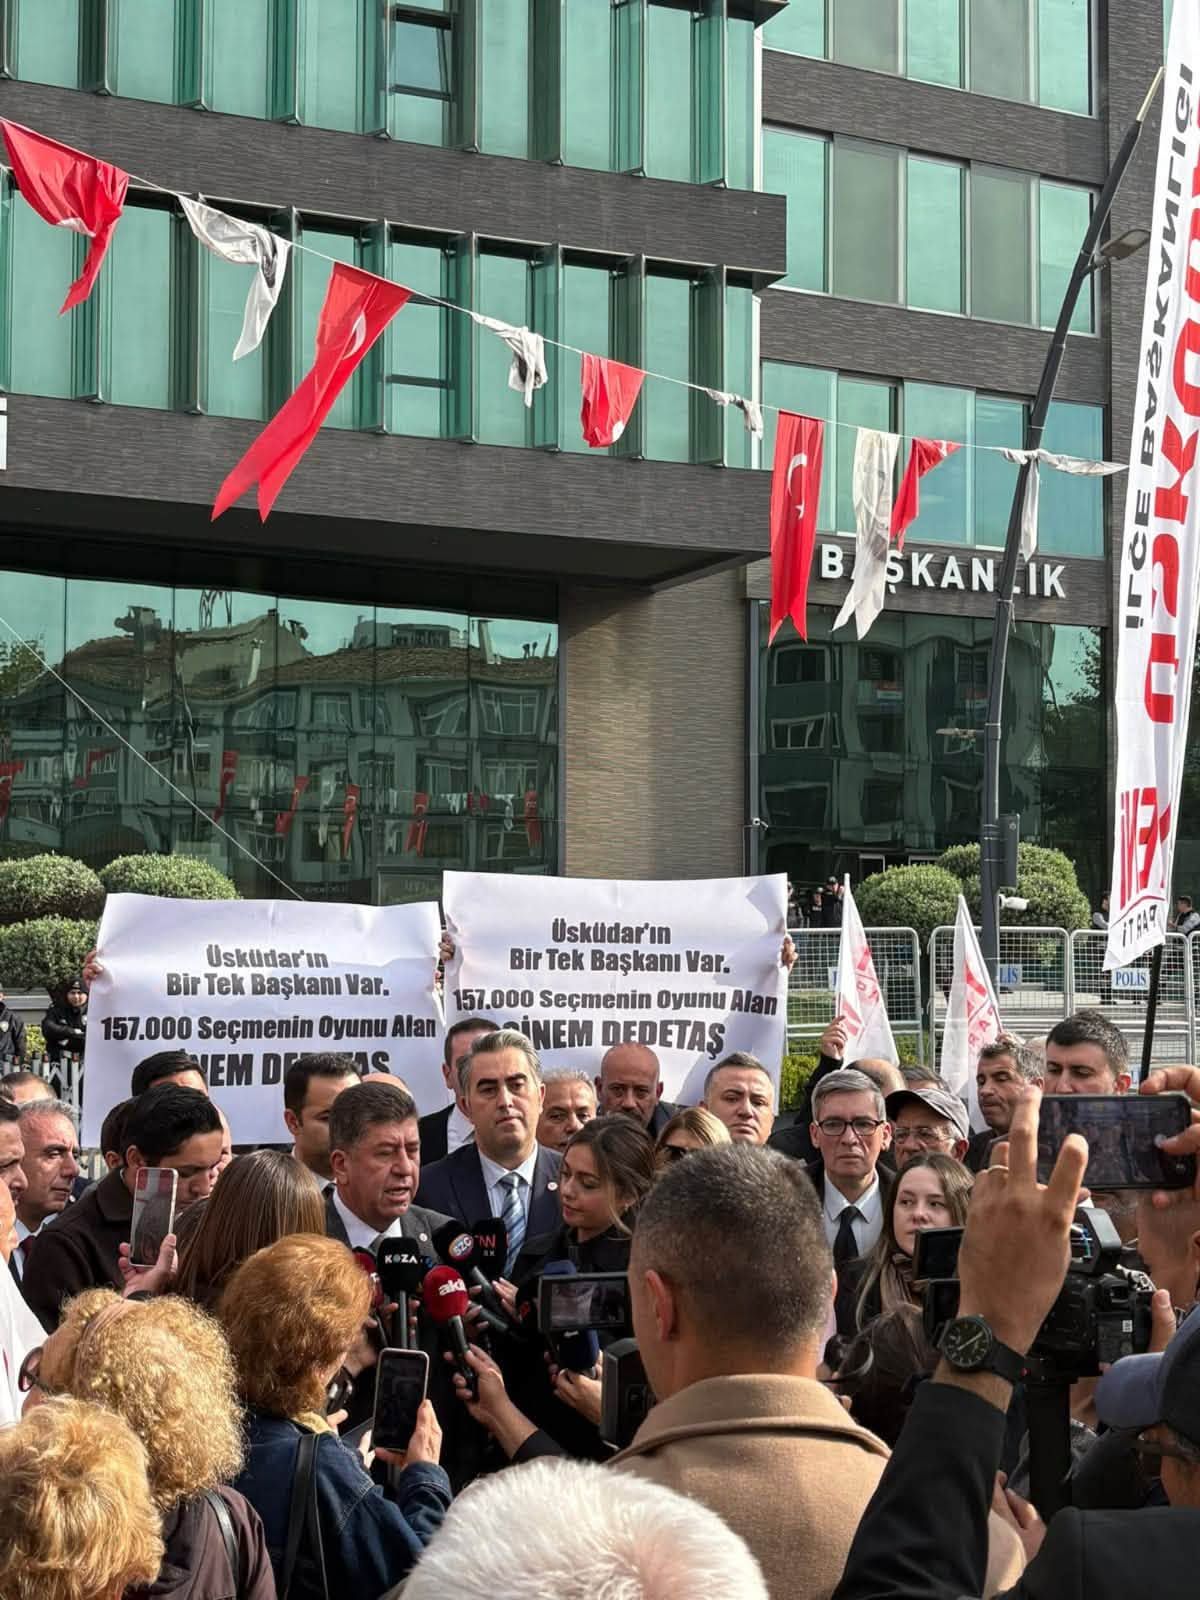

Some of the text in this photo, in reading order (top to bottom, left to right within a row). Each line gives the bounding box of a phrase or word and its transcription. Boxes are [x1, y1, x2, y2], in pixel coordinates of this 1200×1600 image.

[821, 544, 1066, 599] BŞKANIK
[552, 918, 671, 944] Üsküdar'ın
[207, 944, 328, 968] Üsküdar'ın
[510, 948, 731, 976] Bir Tek Başkanı Var.
[166, 973, 390, 1000] Bir Tek Başkanı Var.
[1115, 969, 1147, 986] POLİS
[453, 989, 778, 1016] 157.000 Seçmenin Oyunu Alan
[100, 1014, 436, 1044] 157.000 Seçmenin Oyunu Alan
[602, 1020, 726, 1060] DEDETAŞ
[385, 1254, 418, 1264] KOZA
